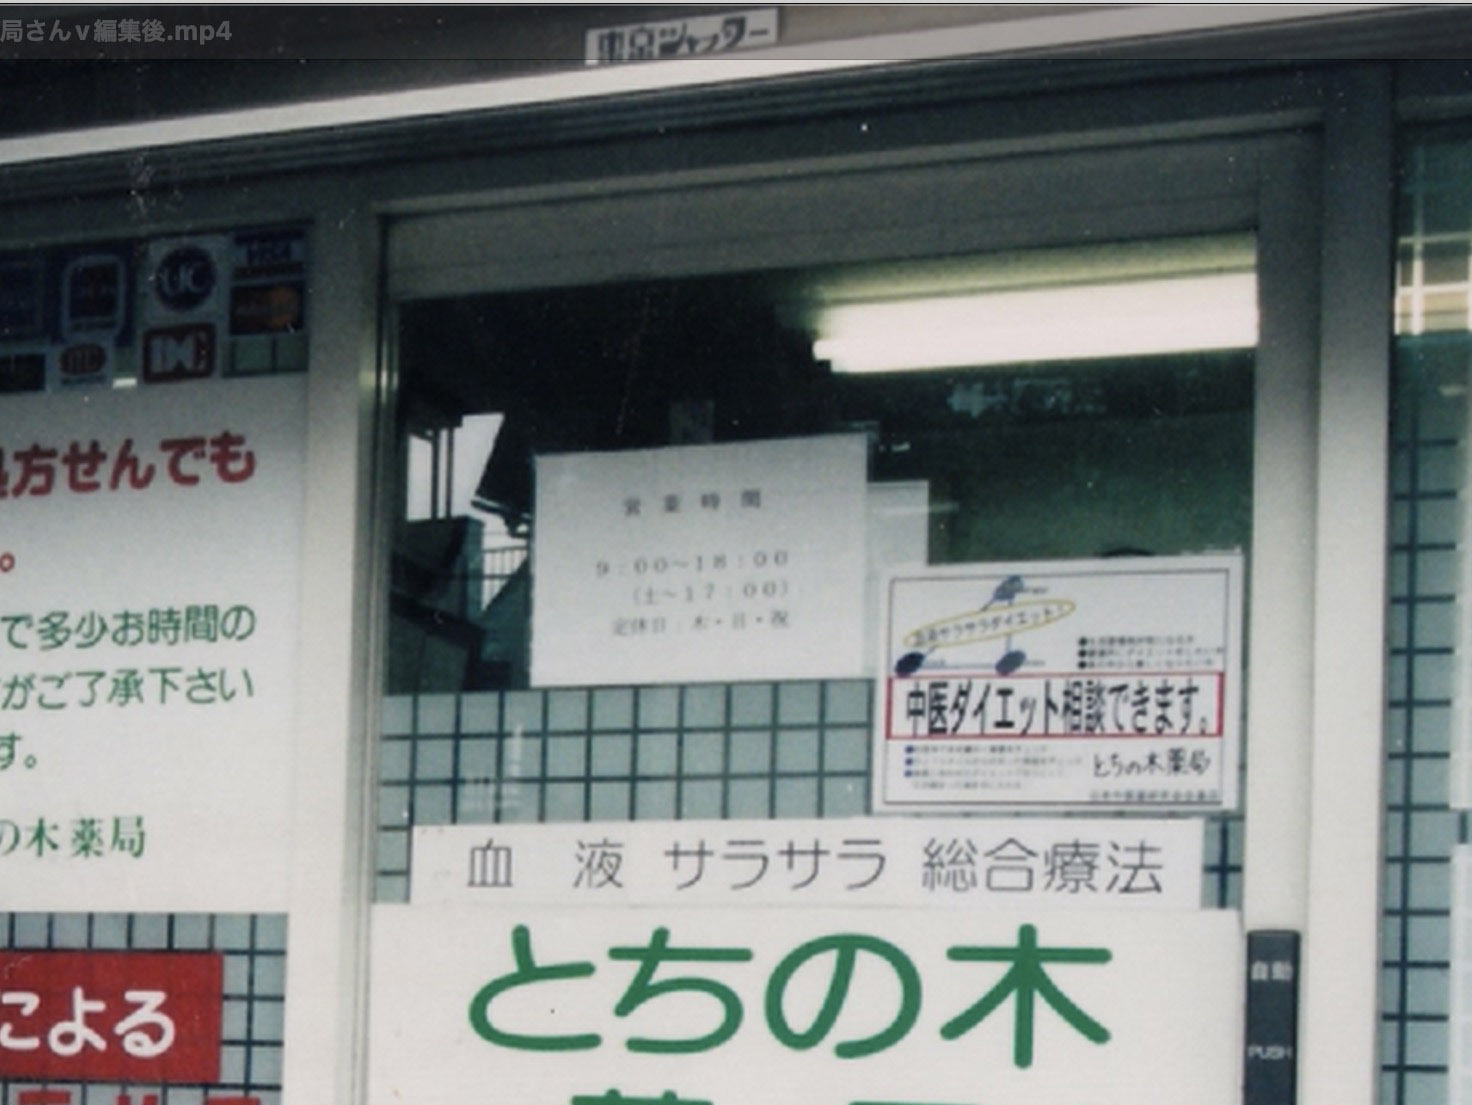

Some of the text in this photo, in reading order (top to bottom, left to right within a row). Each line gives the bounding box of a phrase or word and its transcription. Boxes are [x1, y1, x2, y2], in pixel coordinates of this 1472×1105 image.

[906, 678, 1208, 736] 中医ダイエット相談できます。
[468, 922, 1113, 1069] とちの木
